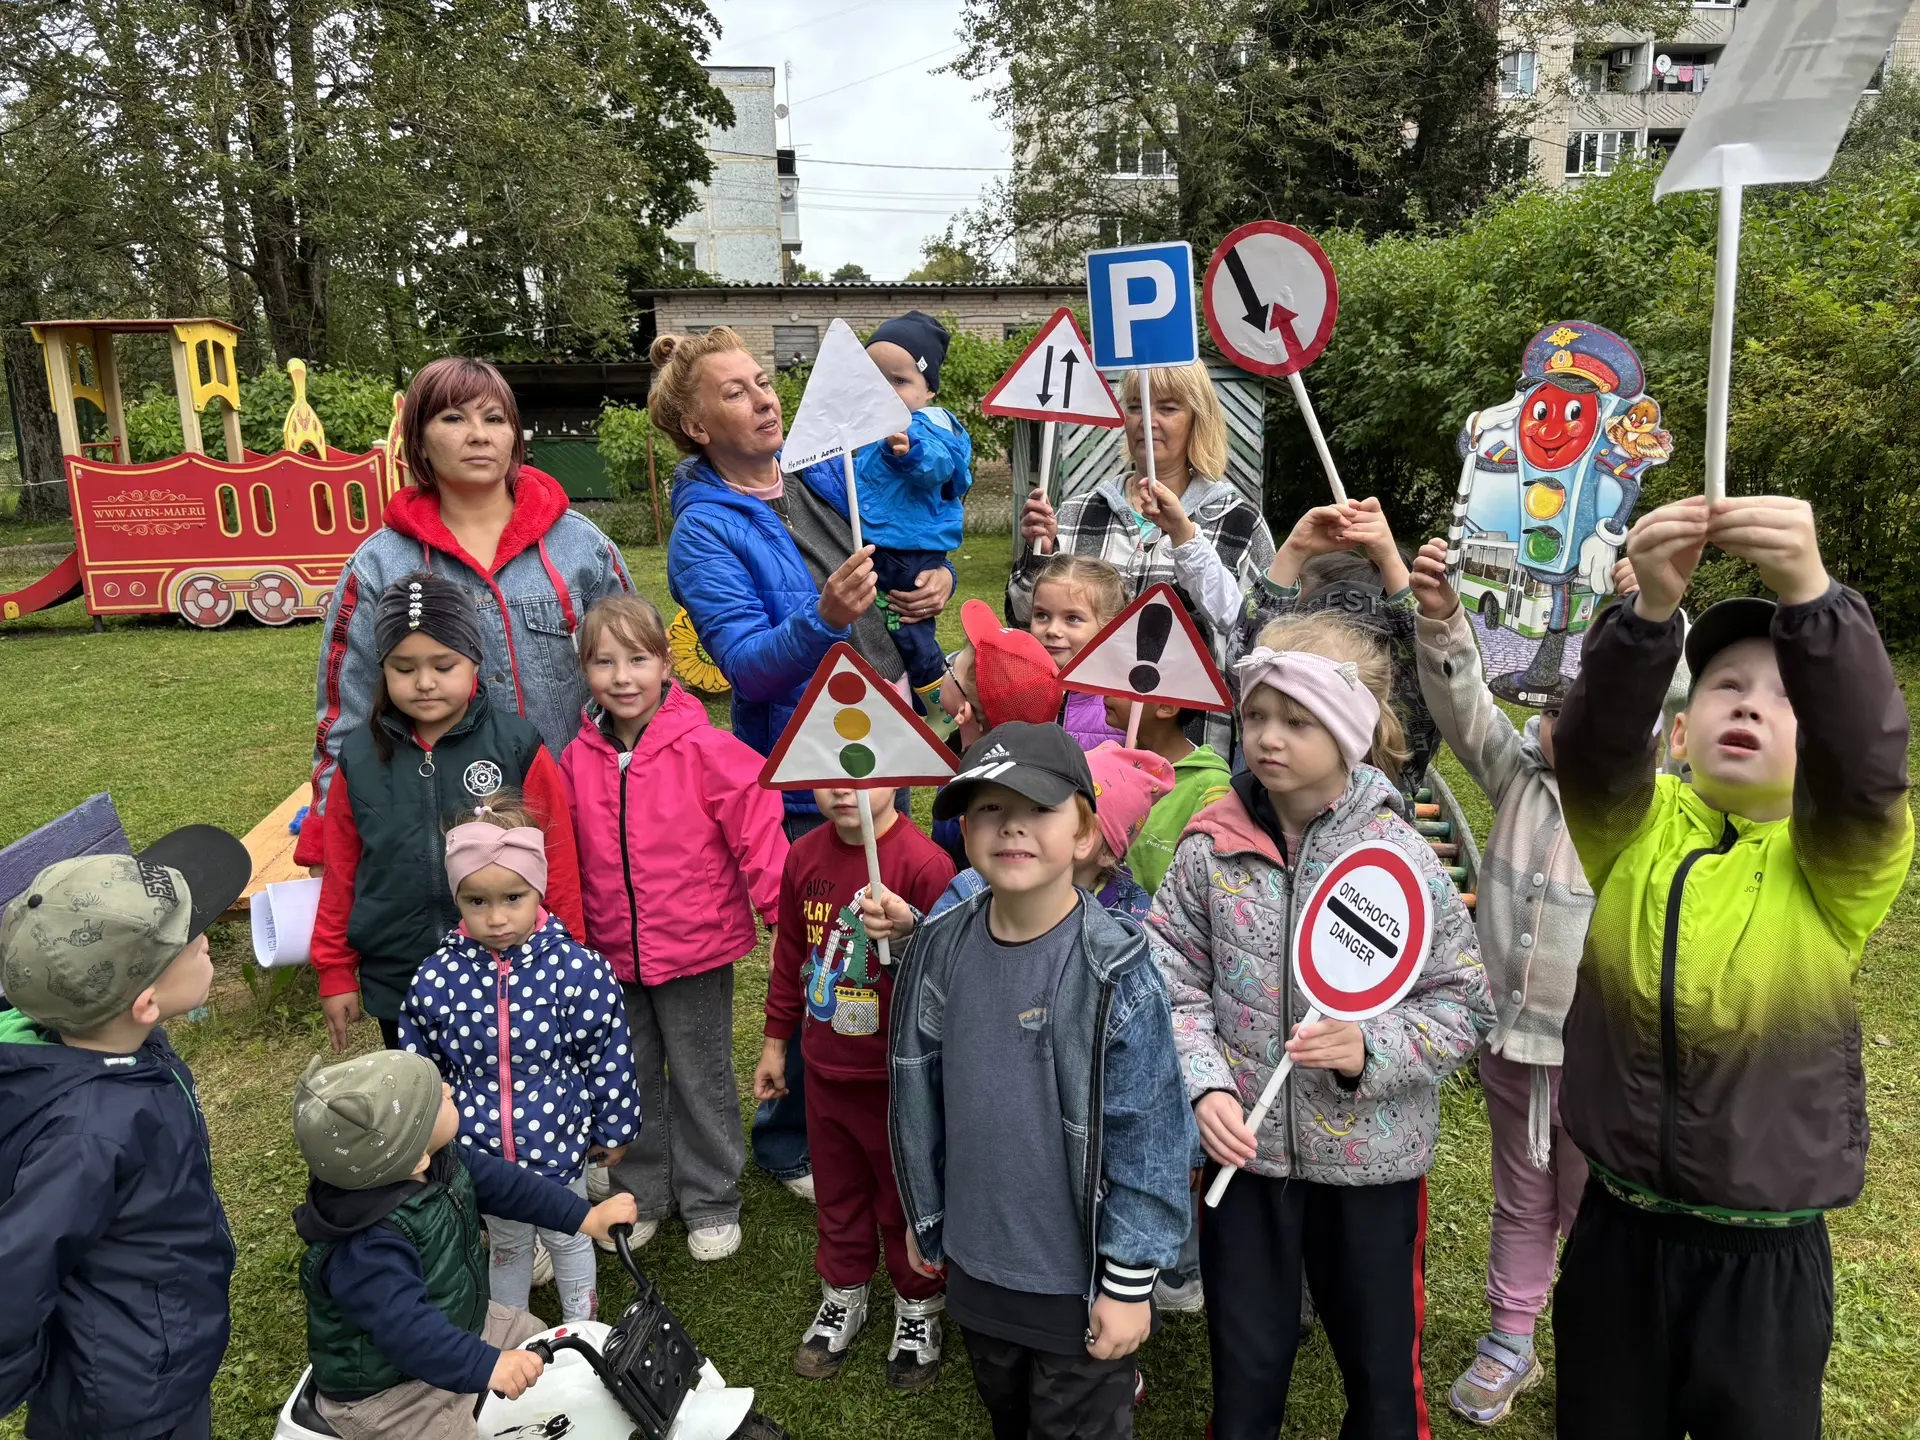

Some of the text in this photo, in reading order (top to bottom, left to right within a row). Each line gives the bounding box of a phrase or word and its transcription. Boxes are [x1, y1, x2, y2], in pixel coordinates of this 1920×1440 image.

[1108, 259, 1177, 359] P
[93, 506, 206, 519] WWW.AVEN-MAF.RU
[806, 879, 836, 897] BUSY
[1339, 882, 1401, 939] ОПАСНОСТЬ
[1329, 921, 1375, 967] DANGER
